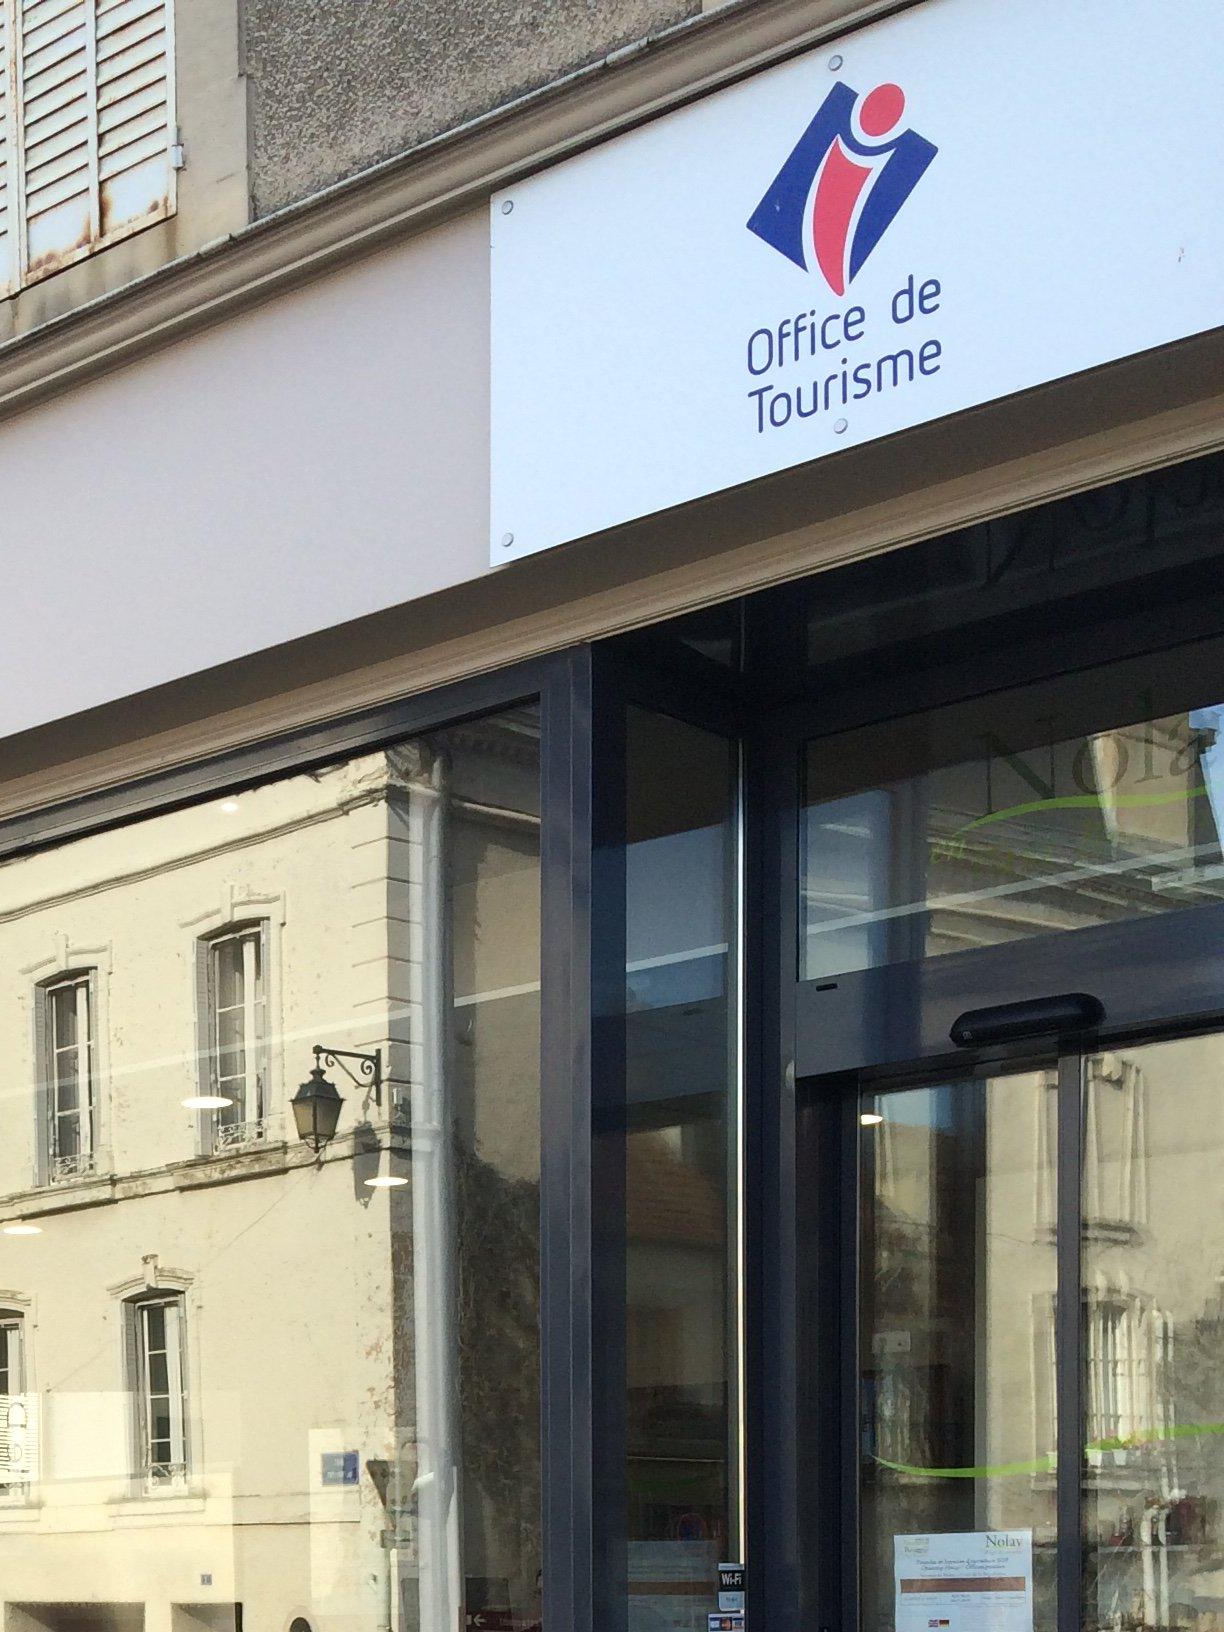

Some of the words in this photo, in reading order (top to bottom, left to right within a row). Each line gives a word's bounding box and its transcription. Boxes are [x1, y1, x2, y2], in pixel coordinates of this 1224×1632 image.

[747, 305, 866, 376] Office
[891, 273, 942, 325] de
[747, 338, 943, 434] Tourisme
[721, 1572, 742, 1586] Wi-Fi
